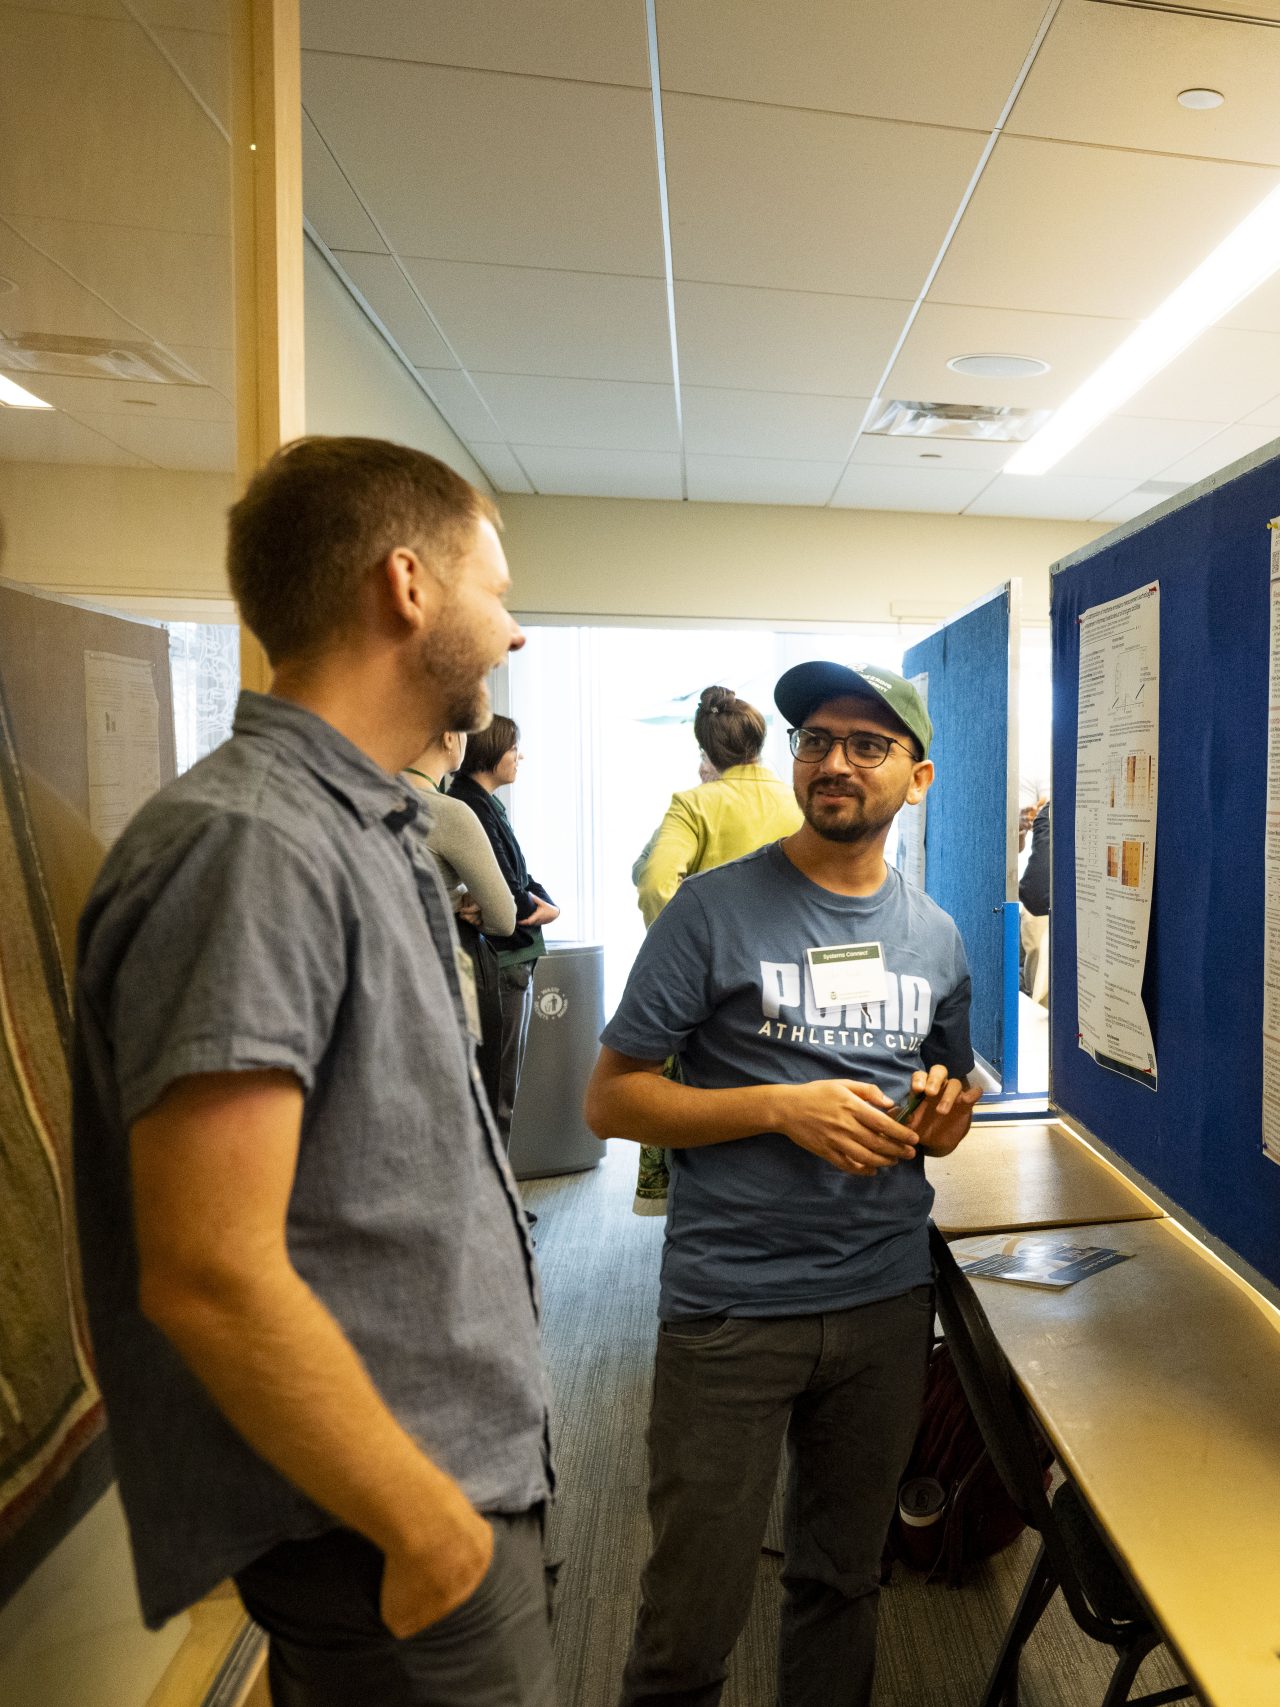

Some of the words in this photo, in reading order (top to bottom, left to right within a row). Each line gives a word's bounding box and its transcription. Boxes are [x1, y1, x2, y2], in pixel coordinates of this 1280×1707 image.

[822, 952, 845, 961] Systems
[846, 950, 868, 958] Connect
[758, 1020, 874, 1048] ATHLETIC
